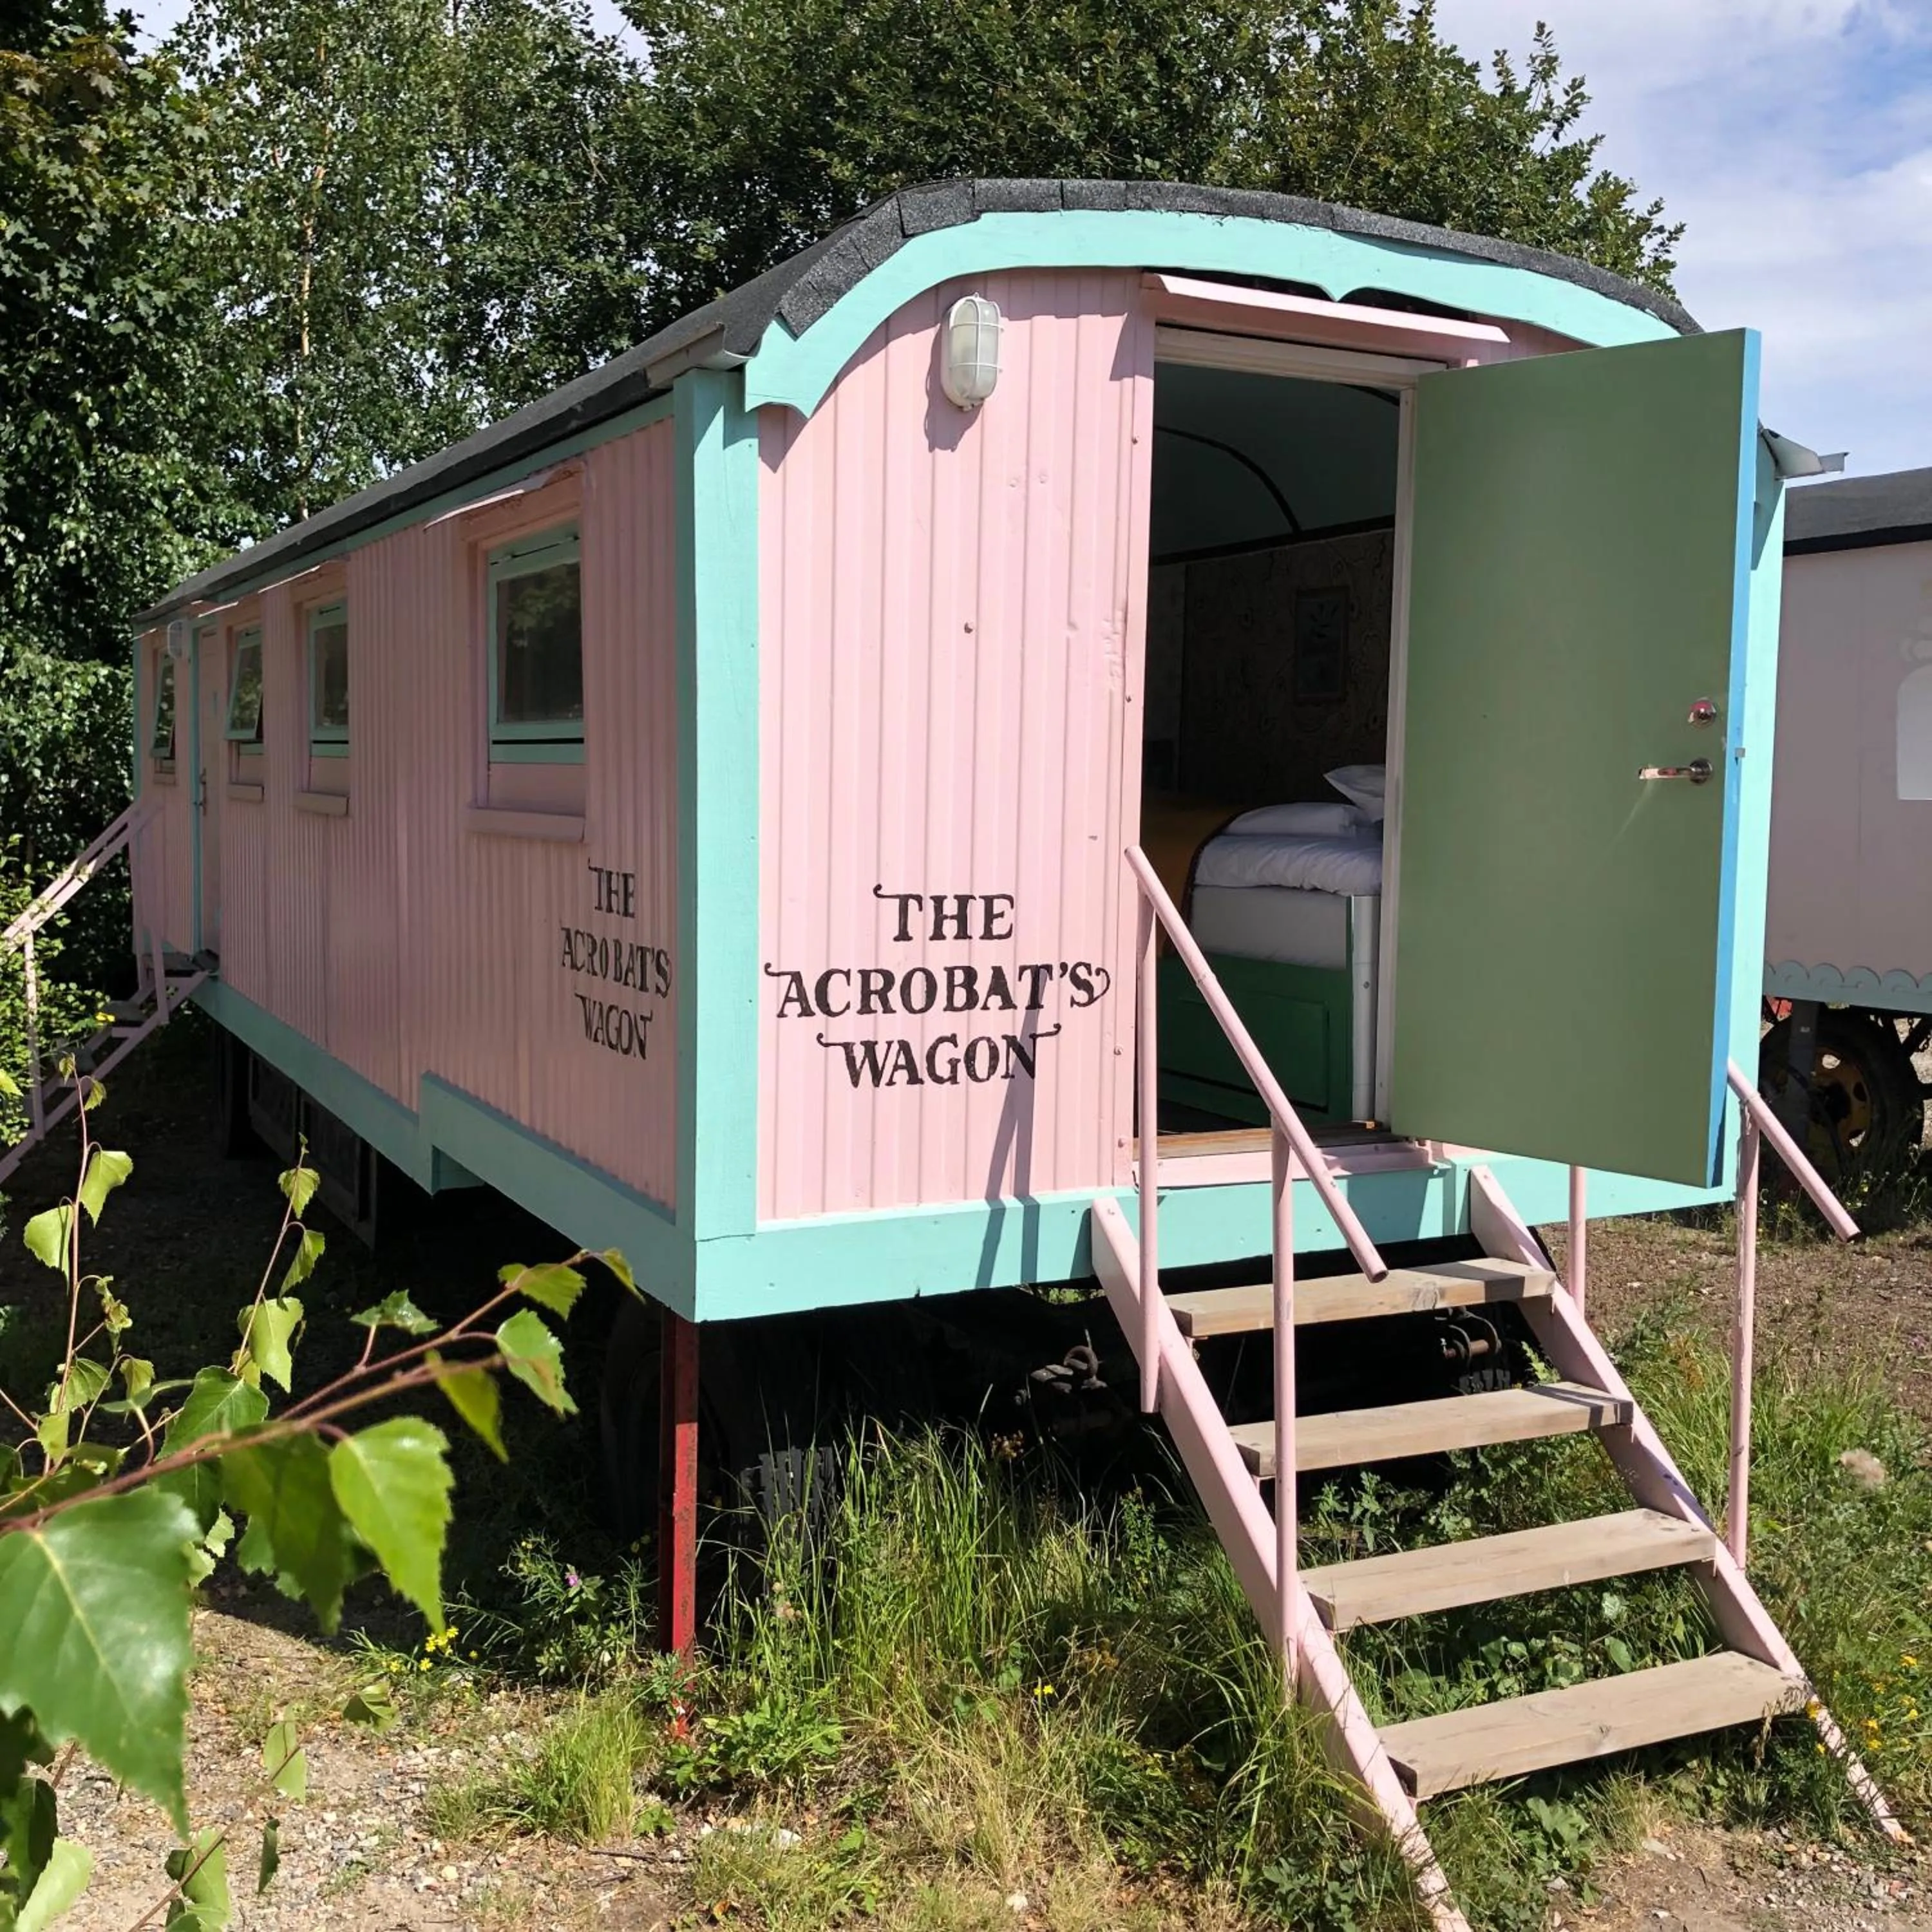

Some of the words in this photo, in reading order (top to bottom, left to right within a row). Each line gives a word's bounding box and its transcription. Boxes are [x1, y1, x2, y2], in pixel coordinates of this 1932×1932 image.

[588, 857, 636, 918] THE
[873, 884, 1014, 942] THE
[765, 961, 1111, 1018] ACROBAT'S
[574, 992, 653, 1060] WAGON
[817, 1023, 1061, 1088] WAGON
